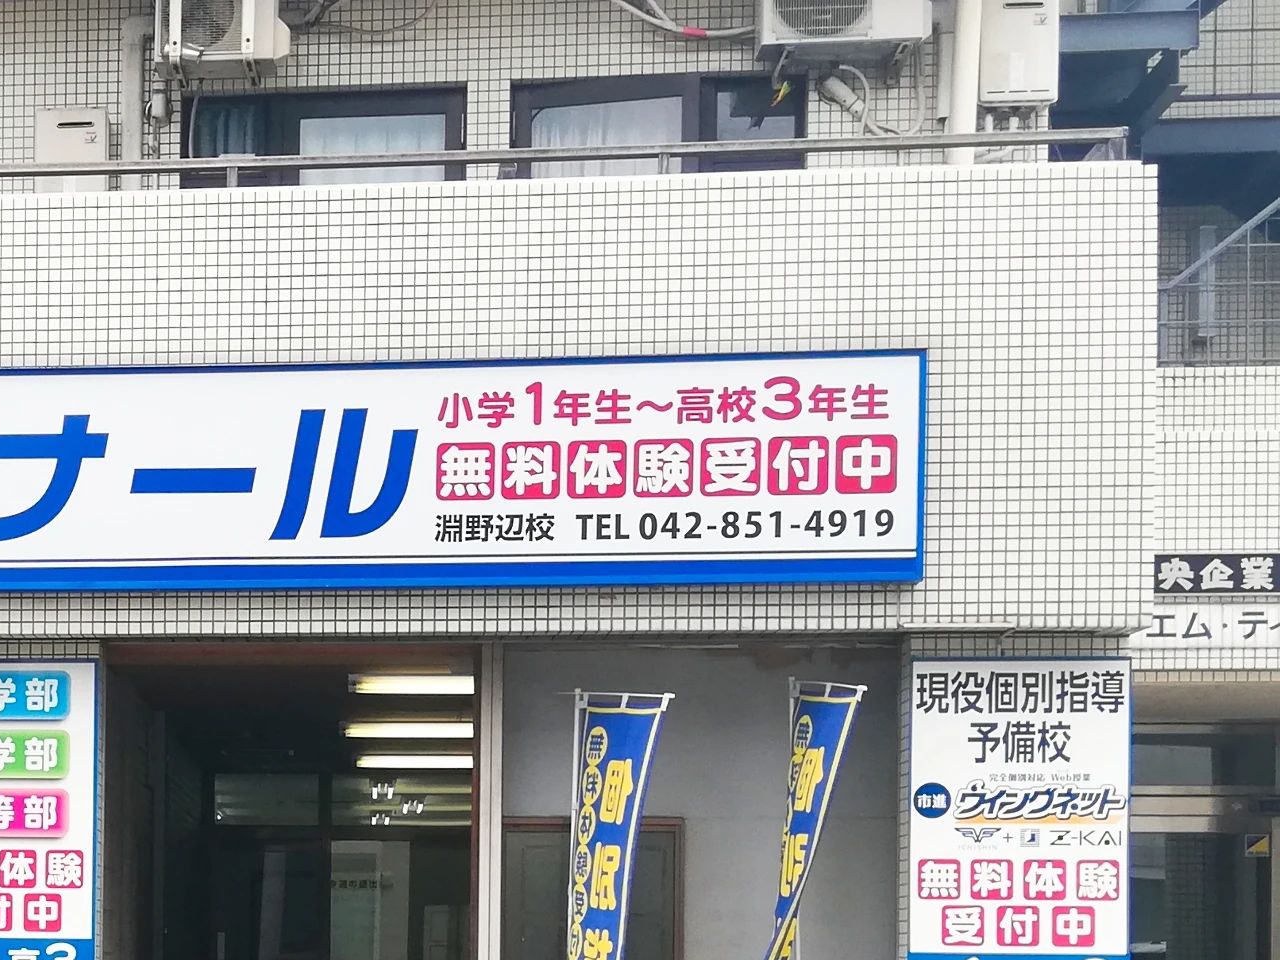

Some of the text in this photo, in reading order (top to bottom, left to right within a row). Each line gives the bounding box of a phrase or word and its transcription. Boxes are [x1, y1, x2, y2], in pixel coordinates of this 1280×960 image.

[438, 375, 890, 428] 小学1年生～高校3年生
[437, 436, 895, 499] 無料体験受付中
[434, 509, 895, 543] 淵野辺校 TEL 042-851-4919
[1158, 557, 1274, 591] 央企業
[916, 671, 1125, 714] 現役個別指導
[967, 721, 1072, 764] 予備校
[917, 793, 947, 809] 市進
[919, 861, 1119, 899] 無料体験
[943, 907, 1094, 945] 受付中
